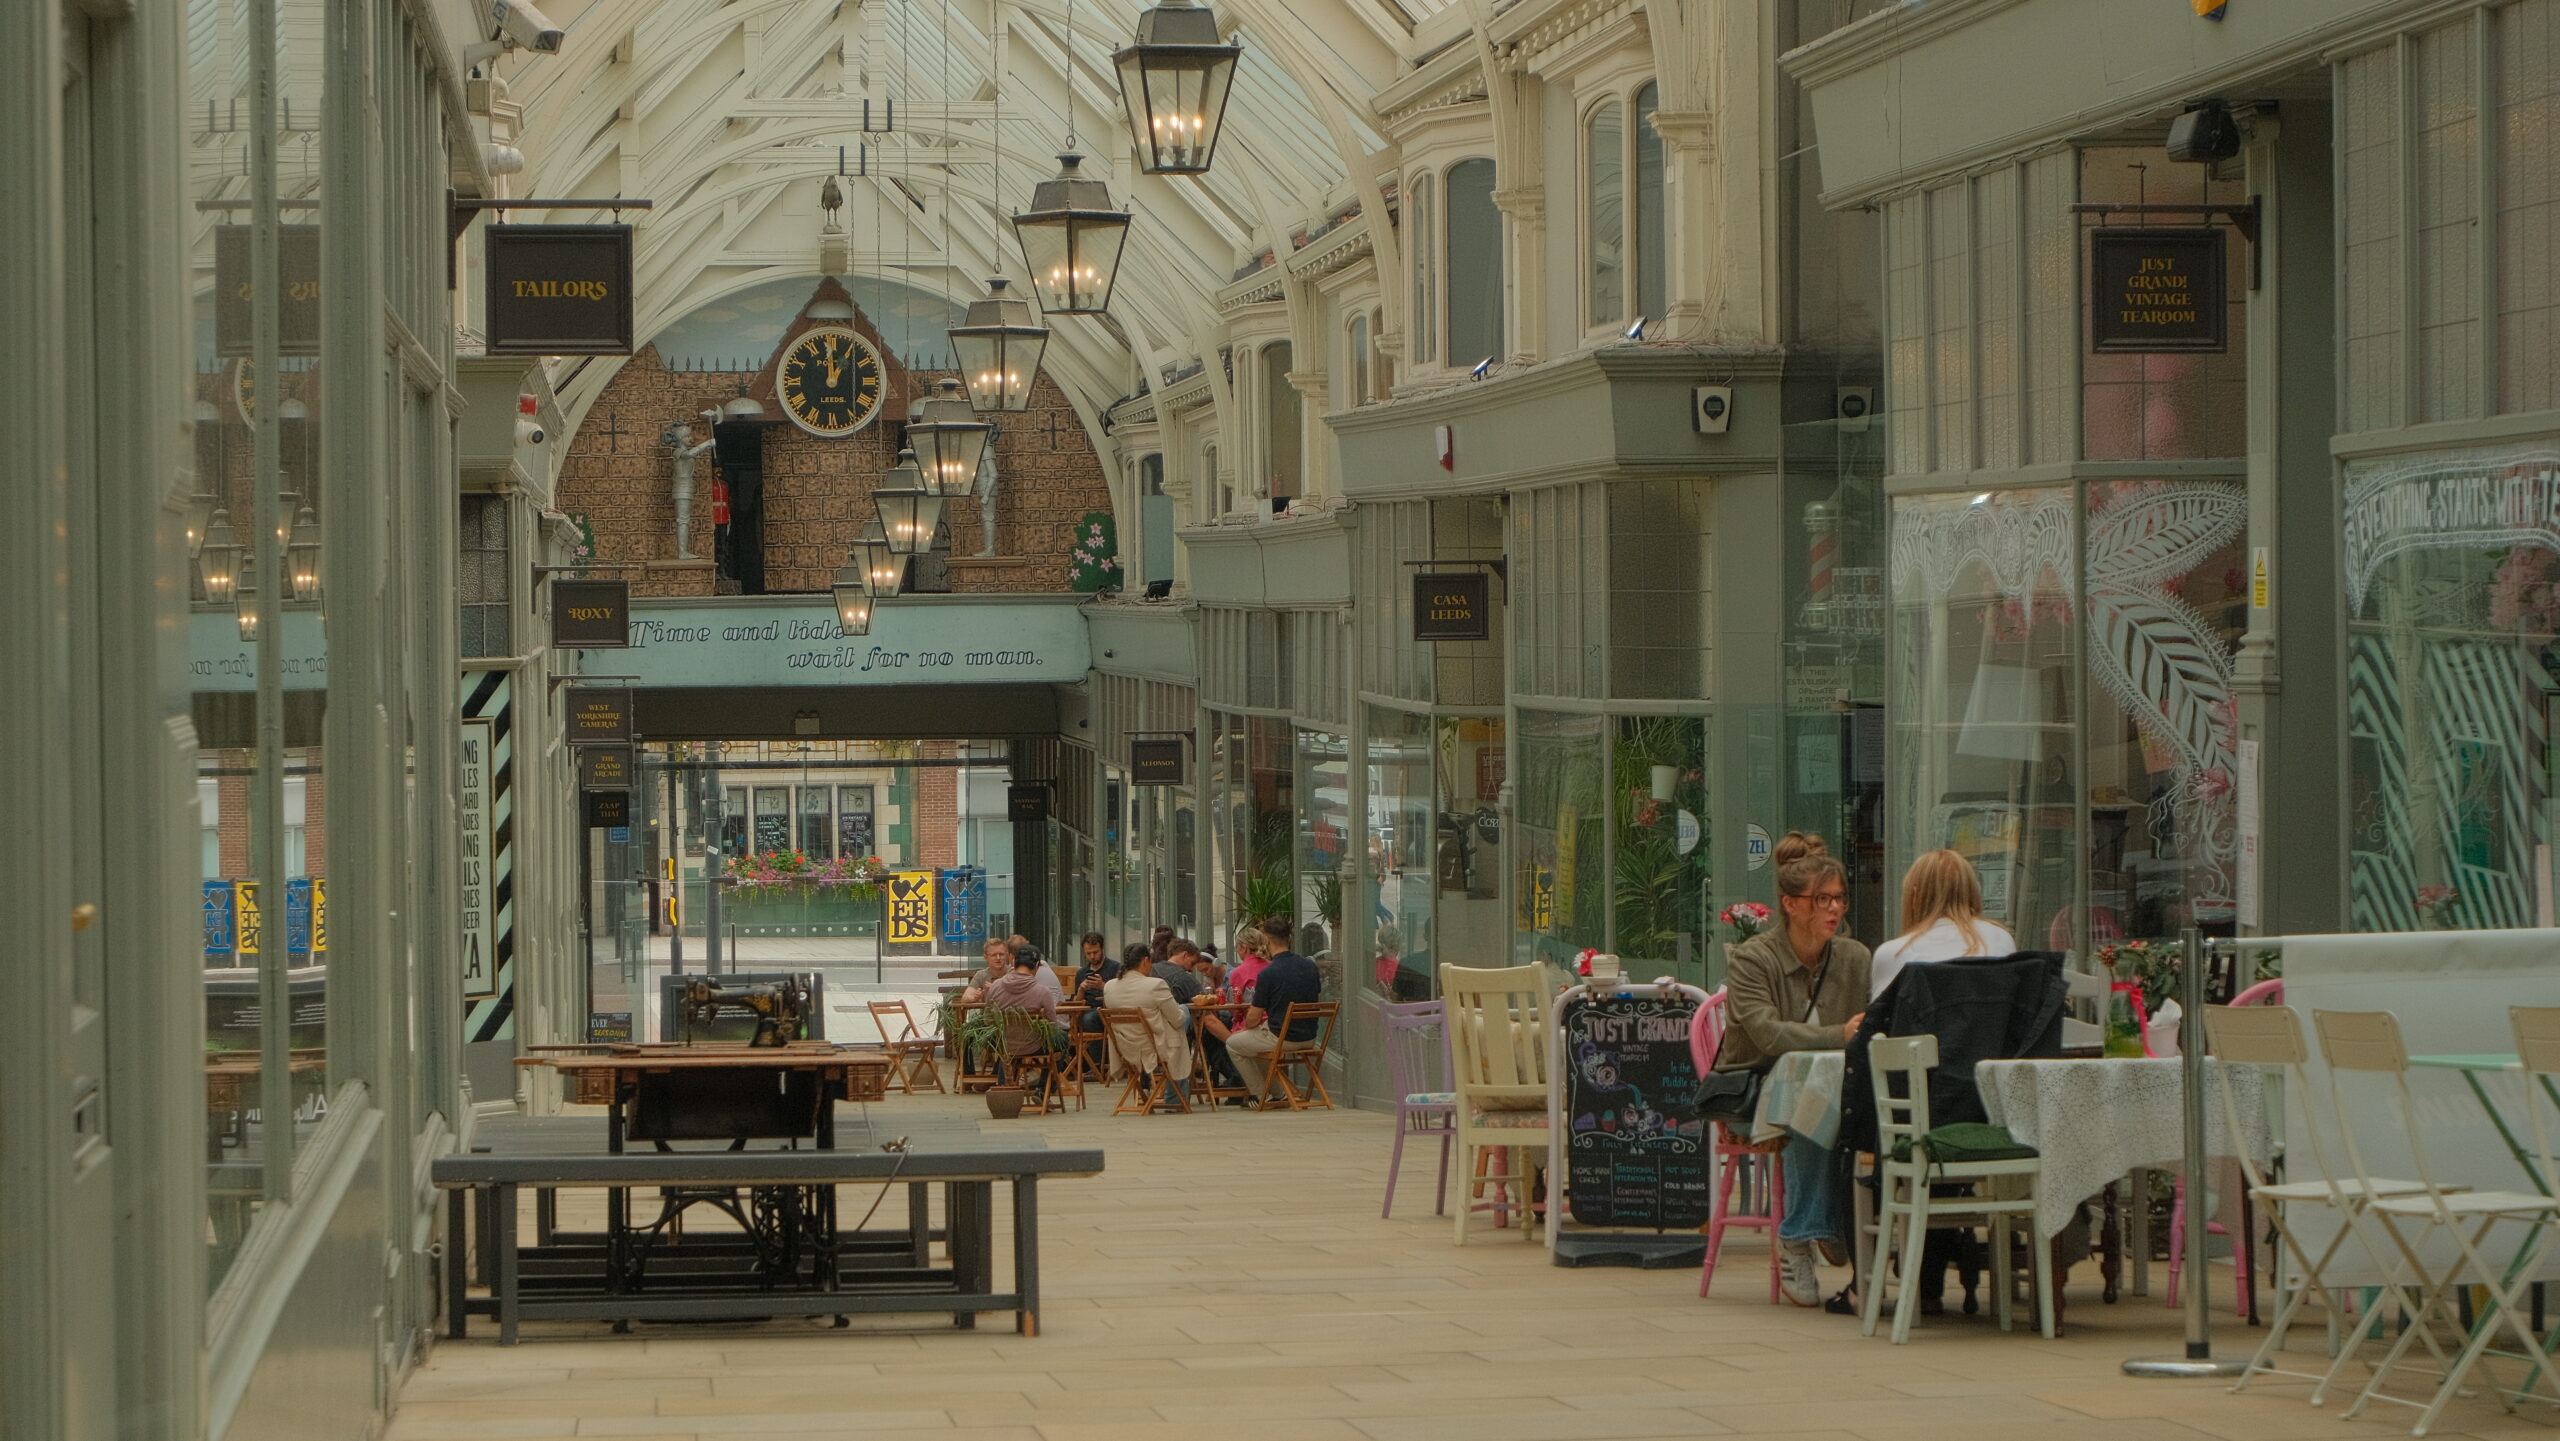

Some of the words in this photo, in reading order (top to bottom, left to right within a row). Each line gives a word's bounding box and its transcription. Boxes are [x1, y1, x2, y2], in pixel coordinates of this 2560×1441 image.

[2139, 258, 2175, 274] JUST
[2127, 275, 2188, 290] GRAND!
[511, 280, 608, 301] TAILORS
[2125, 293, 2192, 306] VINTAGE
[2120, 310, 2197, 325] TEAROOM
[2356, 481, 2432, 551] EVERYTHING
[2438, 477, 2489, 528] STARTS
[2495, 476, 2535, 526] WITH
[2539, 470, 2560, 526] TE
[1433, 595, 1468, 606] CASA
[567, 607, 613, 621] ROXY
[1431, 609, 1472, 620] LEEDS
[629, 621, 711, 648] Time
[722, 620, 779, 641] and
[788, 619, 845, 640] tide
[786, 647, 855, 668] wait
[861, 646, 910, 672] for
[919, 652, 954, 667] no
[965, 651, 1043, 666] man.
[576, 712, 622, 721] YORKSHIRE
[580, 721, 618, 729] CAMERAS
[1582, 1017, 1634, 1043] JUST
